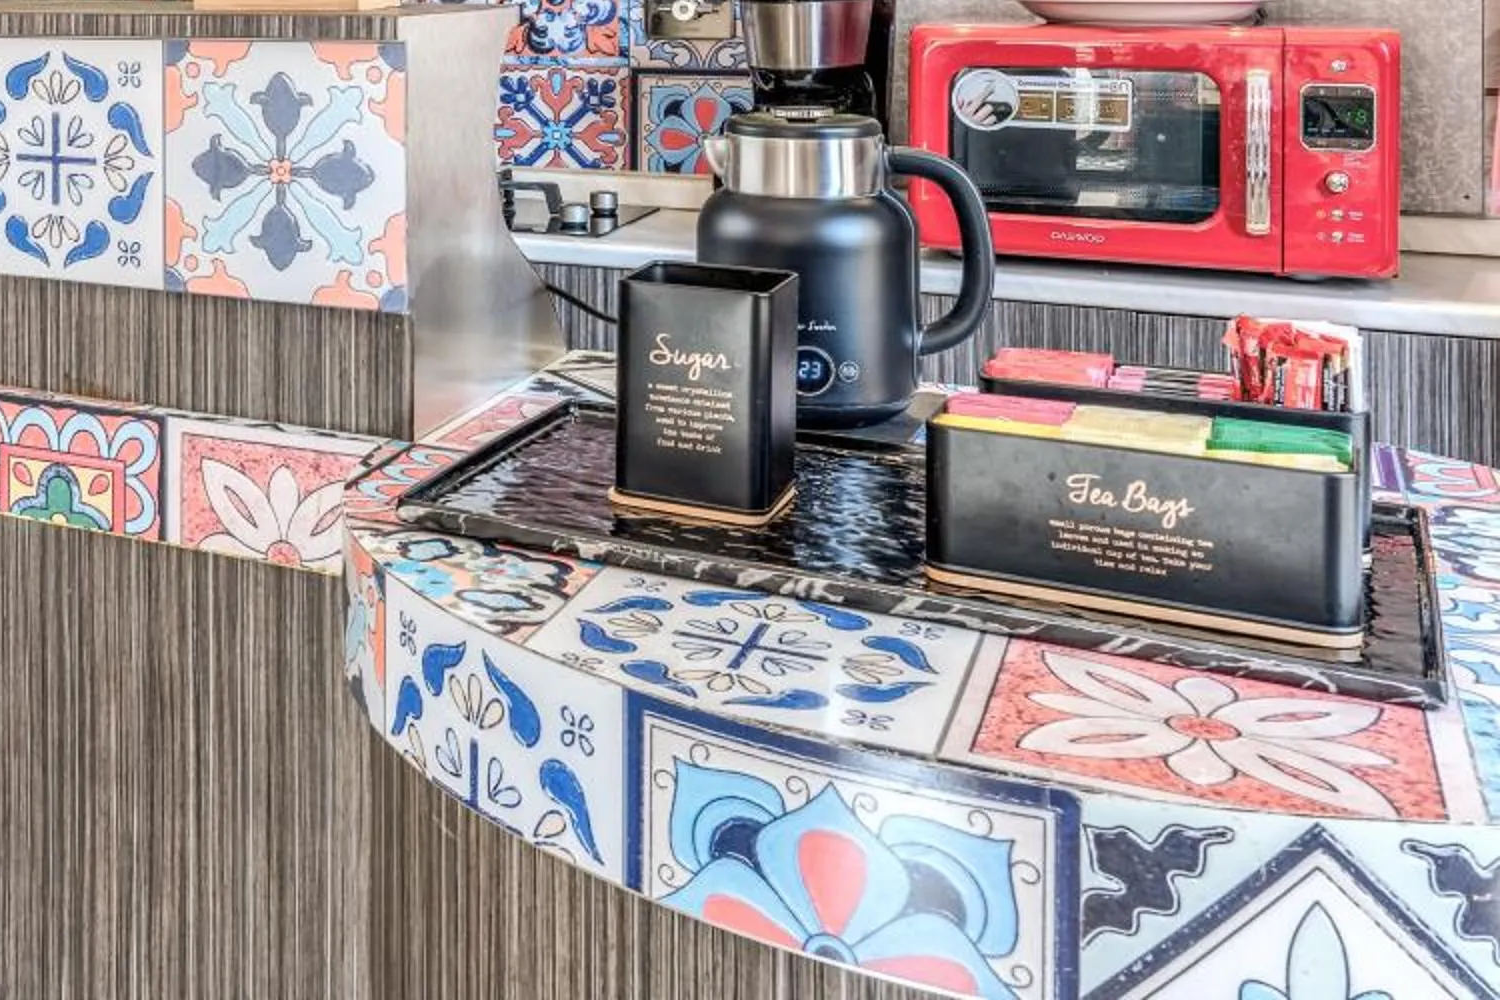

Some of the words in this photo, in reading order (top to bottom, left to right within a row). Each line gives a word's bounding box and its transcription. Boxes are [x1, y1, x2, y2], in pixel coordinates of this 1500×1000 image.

[649, 333, 732, 381] Sugar
[798, 361, 821, 379] 23
[1066, 473, 1117, 507] Tea
[1121, 479, 1195, 529] Bags
